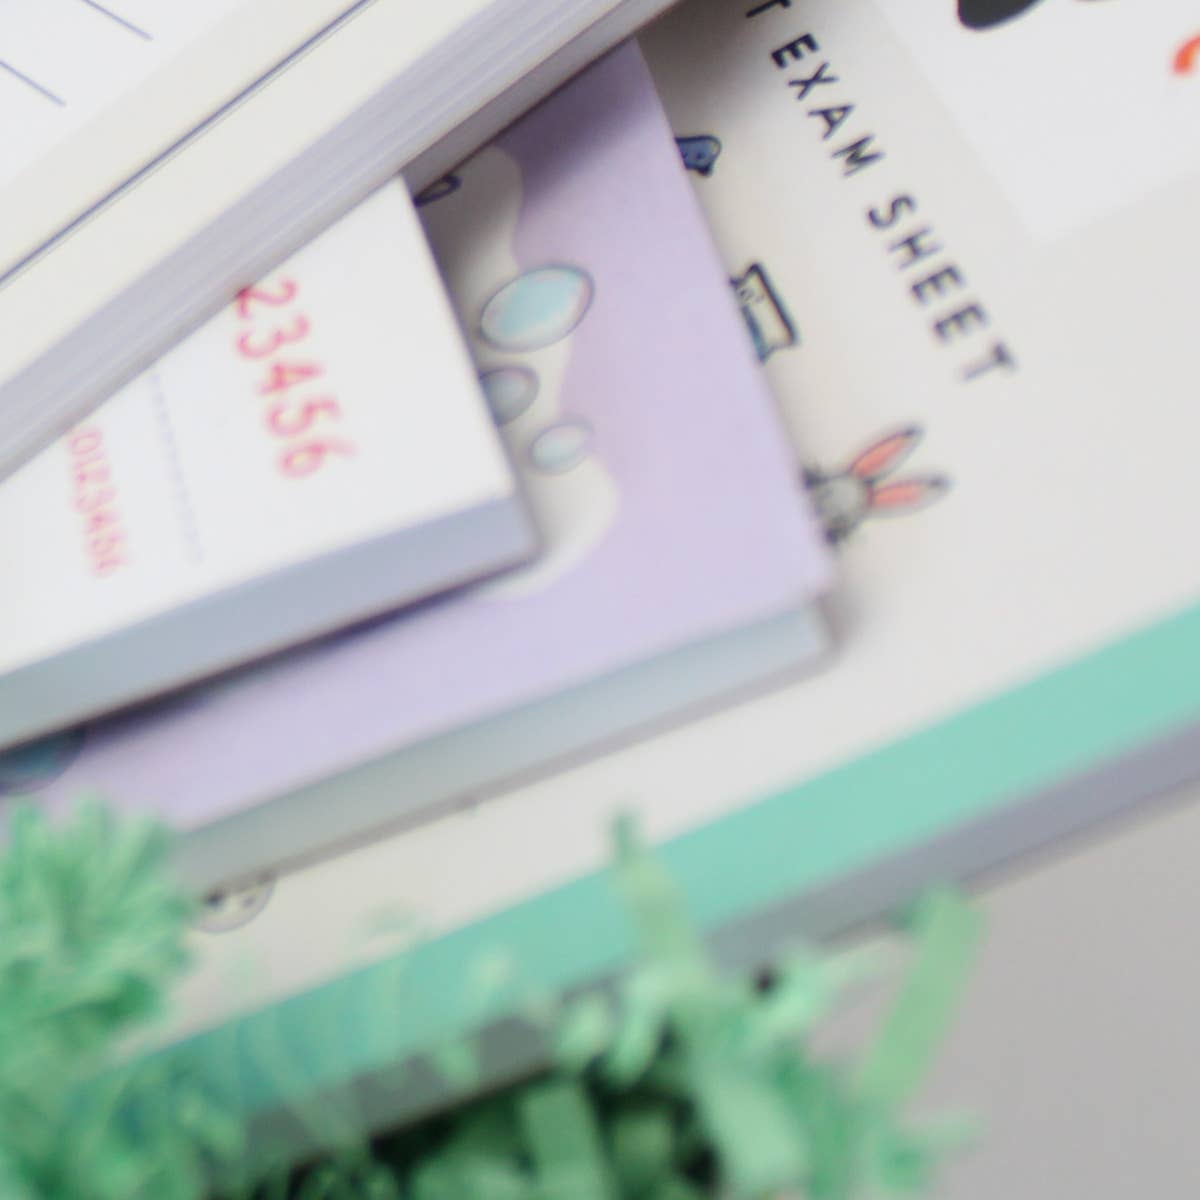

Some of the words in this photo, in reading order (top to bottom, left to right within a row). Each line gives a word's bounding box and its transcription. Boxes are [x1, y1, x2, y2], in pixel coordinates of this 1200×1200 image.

[770, 32, 886, 177] EXAM
[866, 193, 1018, 383] SHEET
[234, 274, 362, 478] 23456
